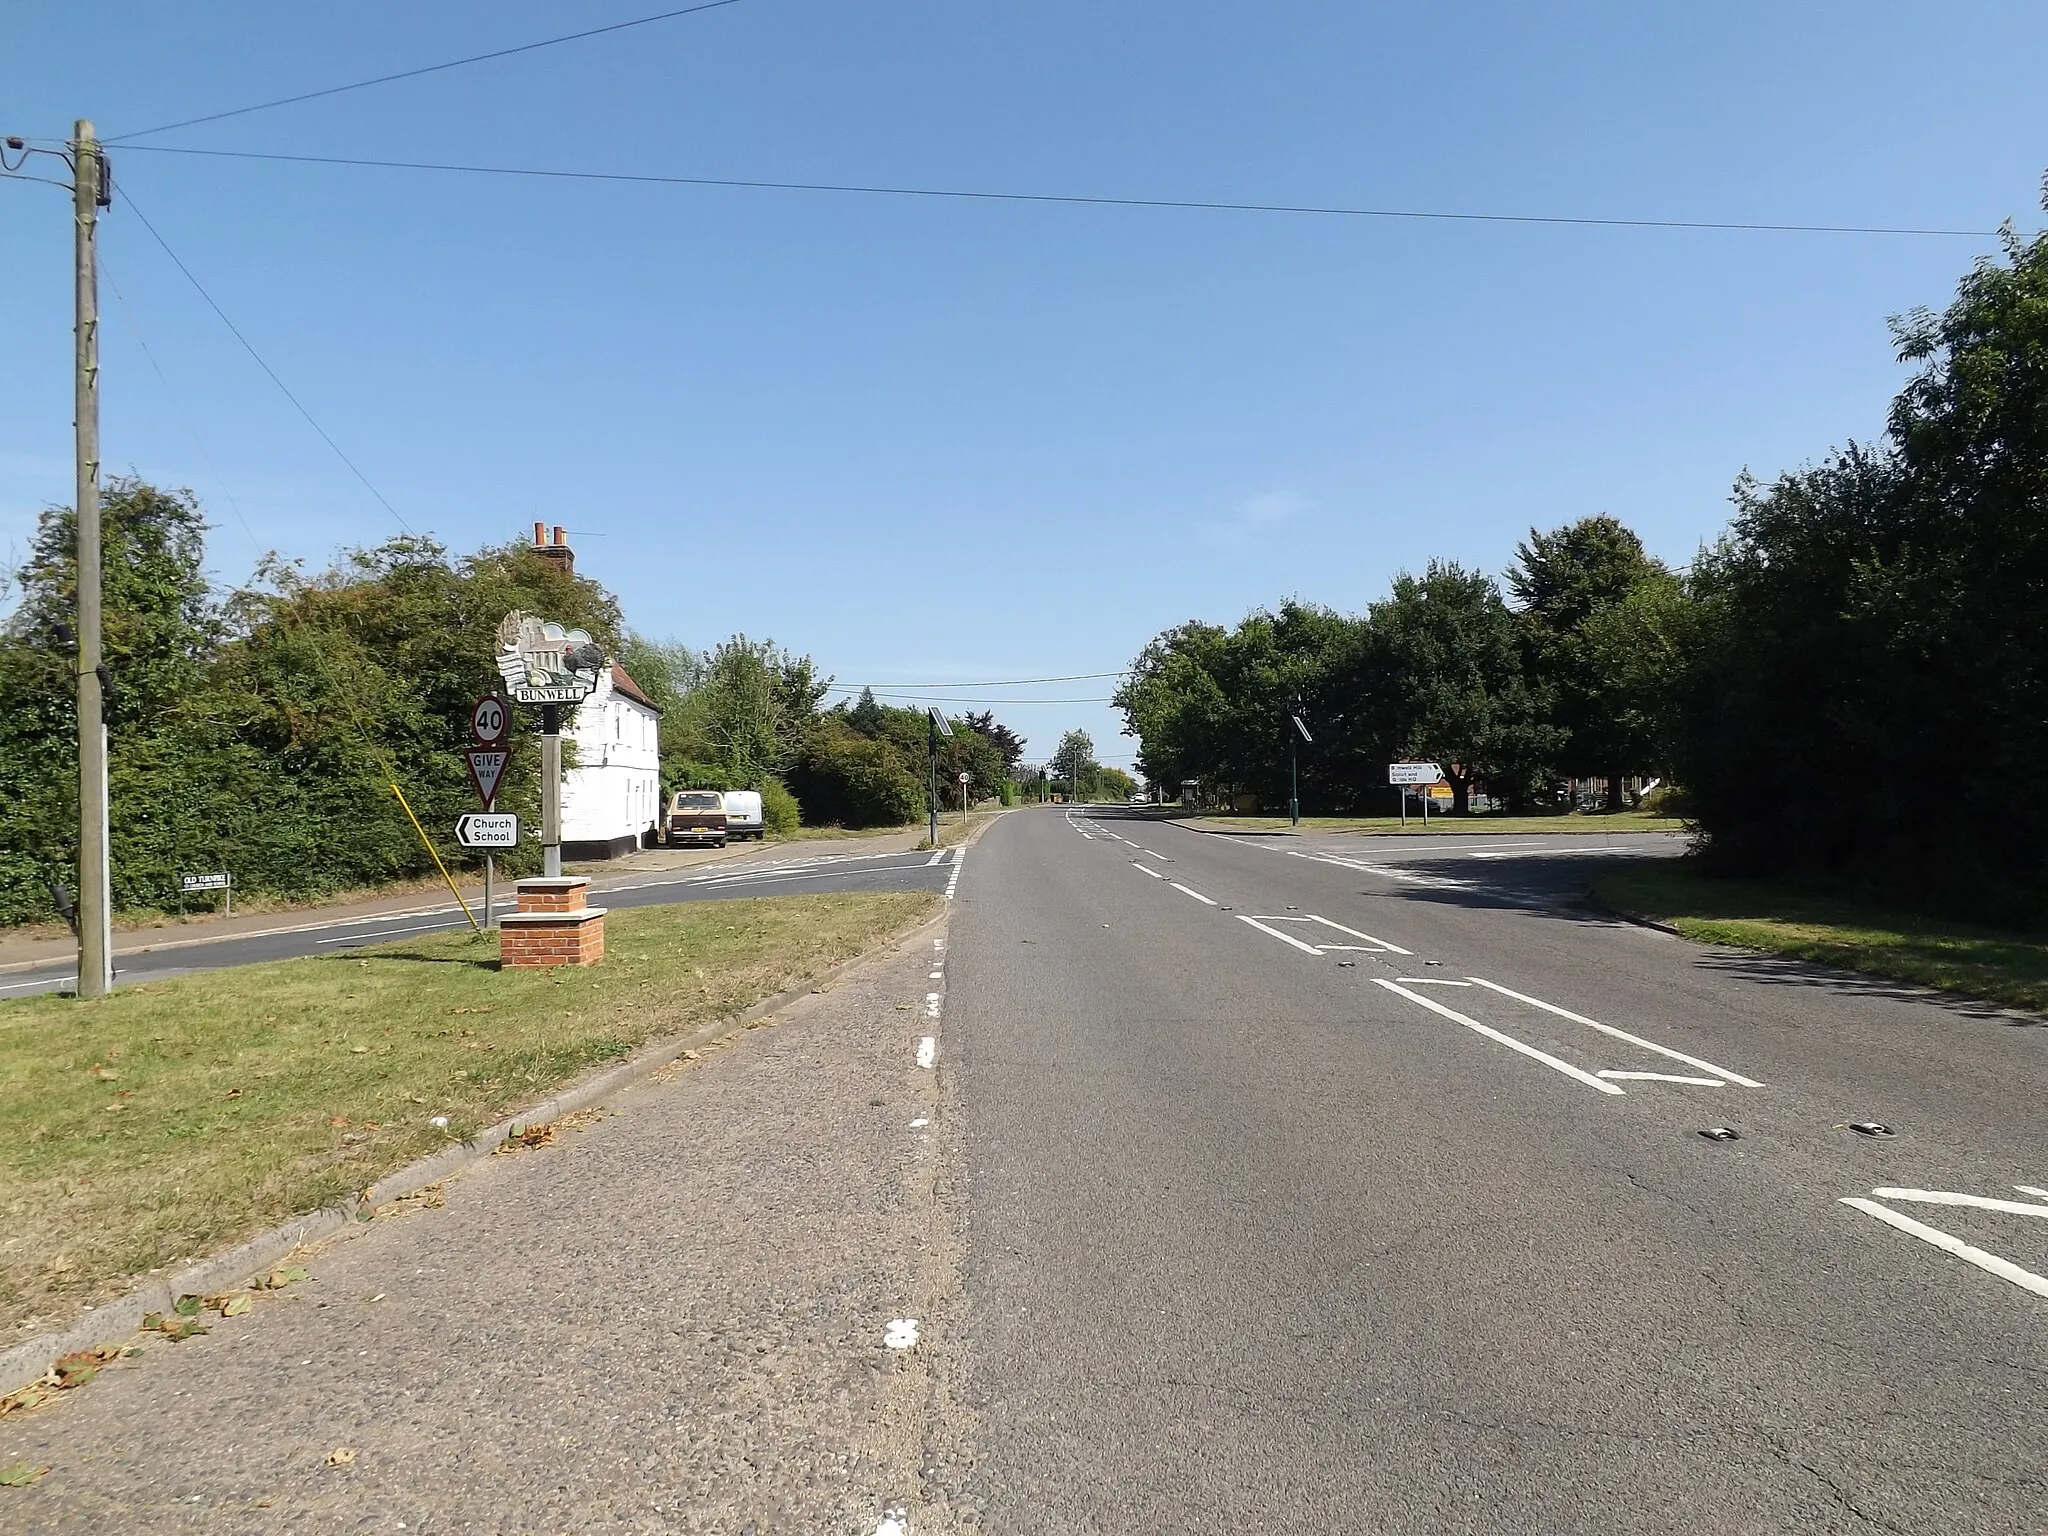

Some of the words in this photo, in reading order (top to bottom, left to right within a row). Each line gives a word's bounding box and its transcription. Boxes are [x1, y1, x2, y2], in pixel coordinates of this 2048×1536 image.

[521, 689, 581, 700] BUNWELL
[477, 711, 501, 731] 40
[474, 755, 500, 766] GIVE
[478, 770, 496, 778] WAY
[474, 819, 511, 828] Church
[474, 832, 510, 841] School
[184, 876, 197, 884] OLD
